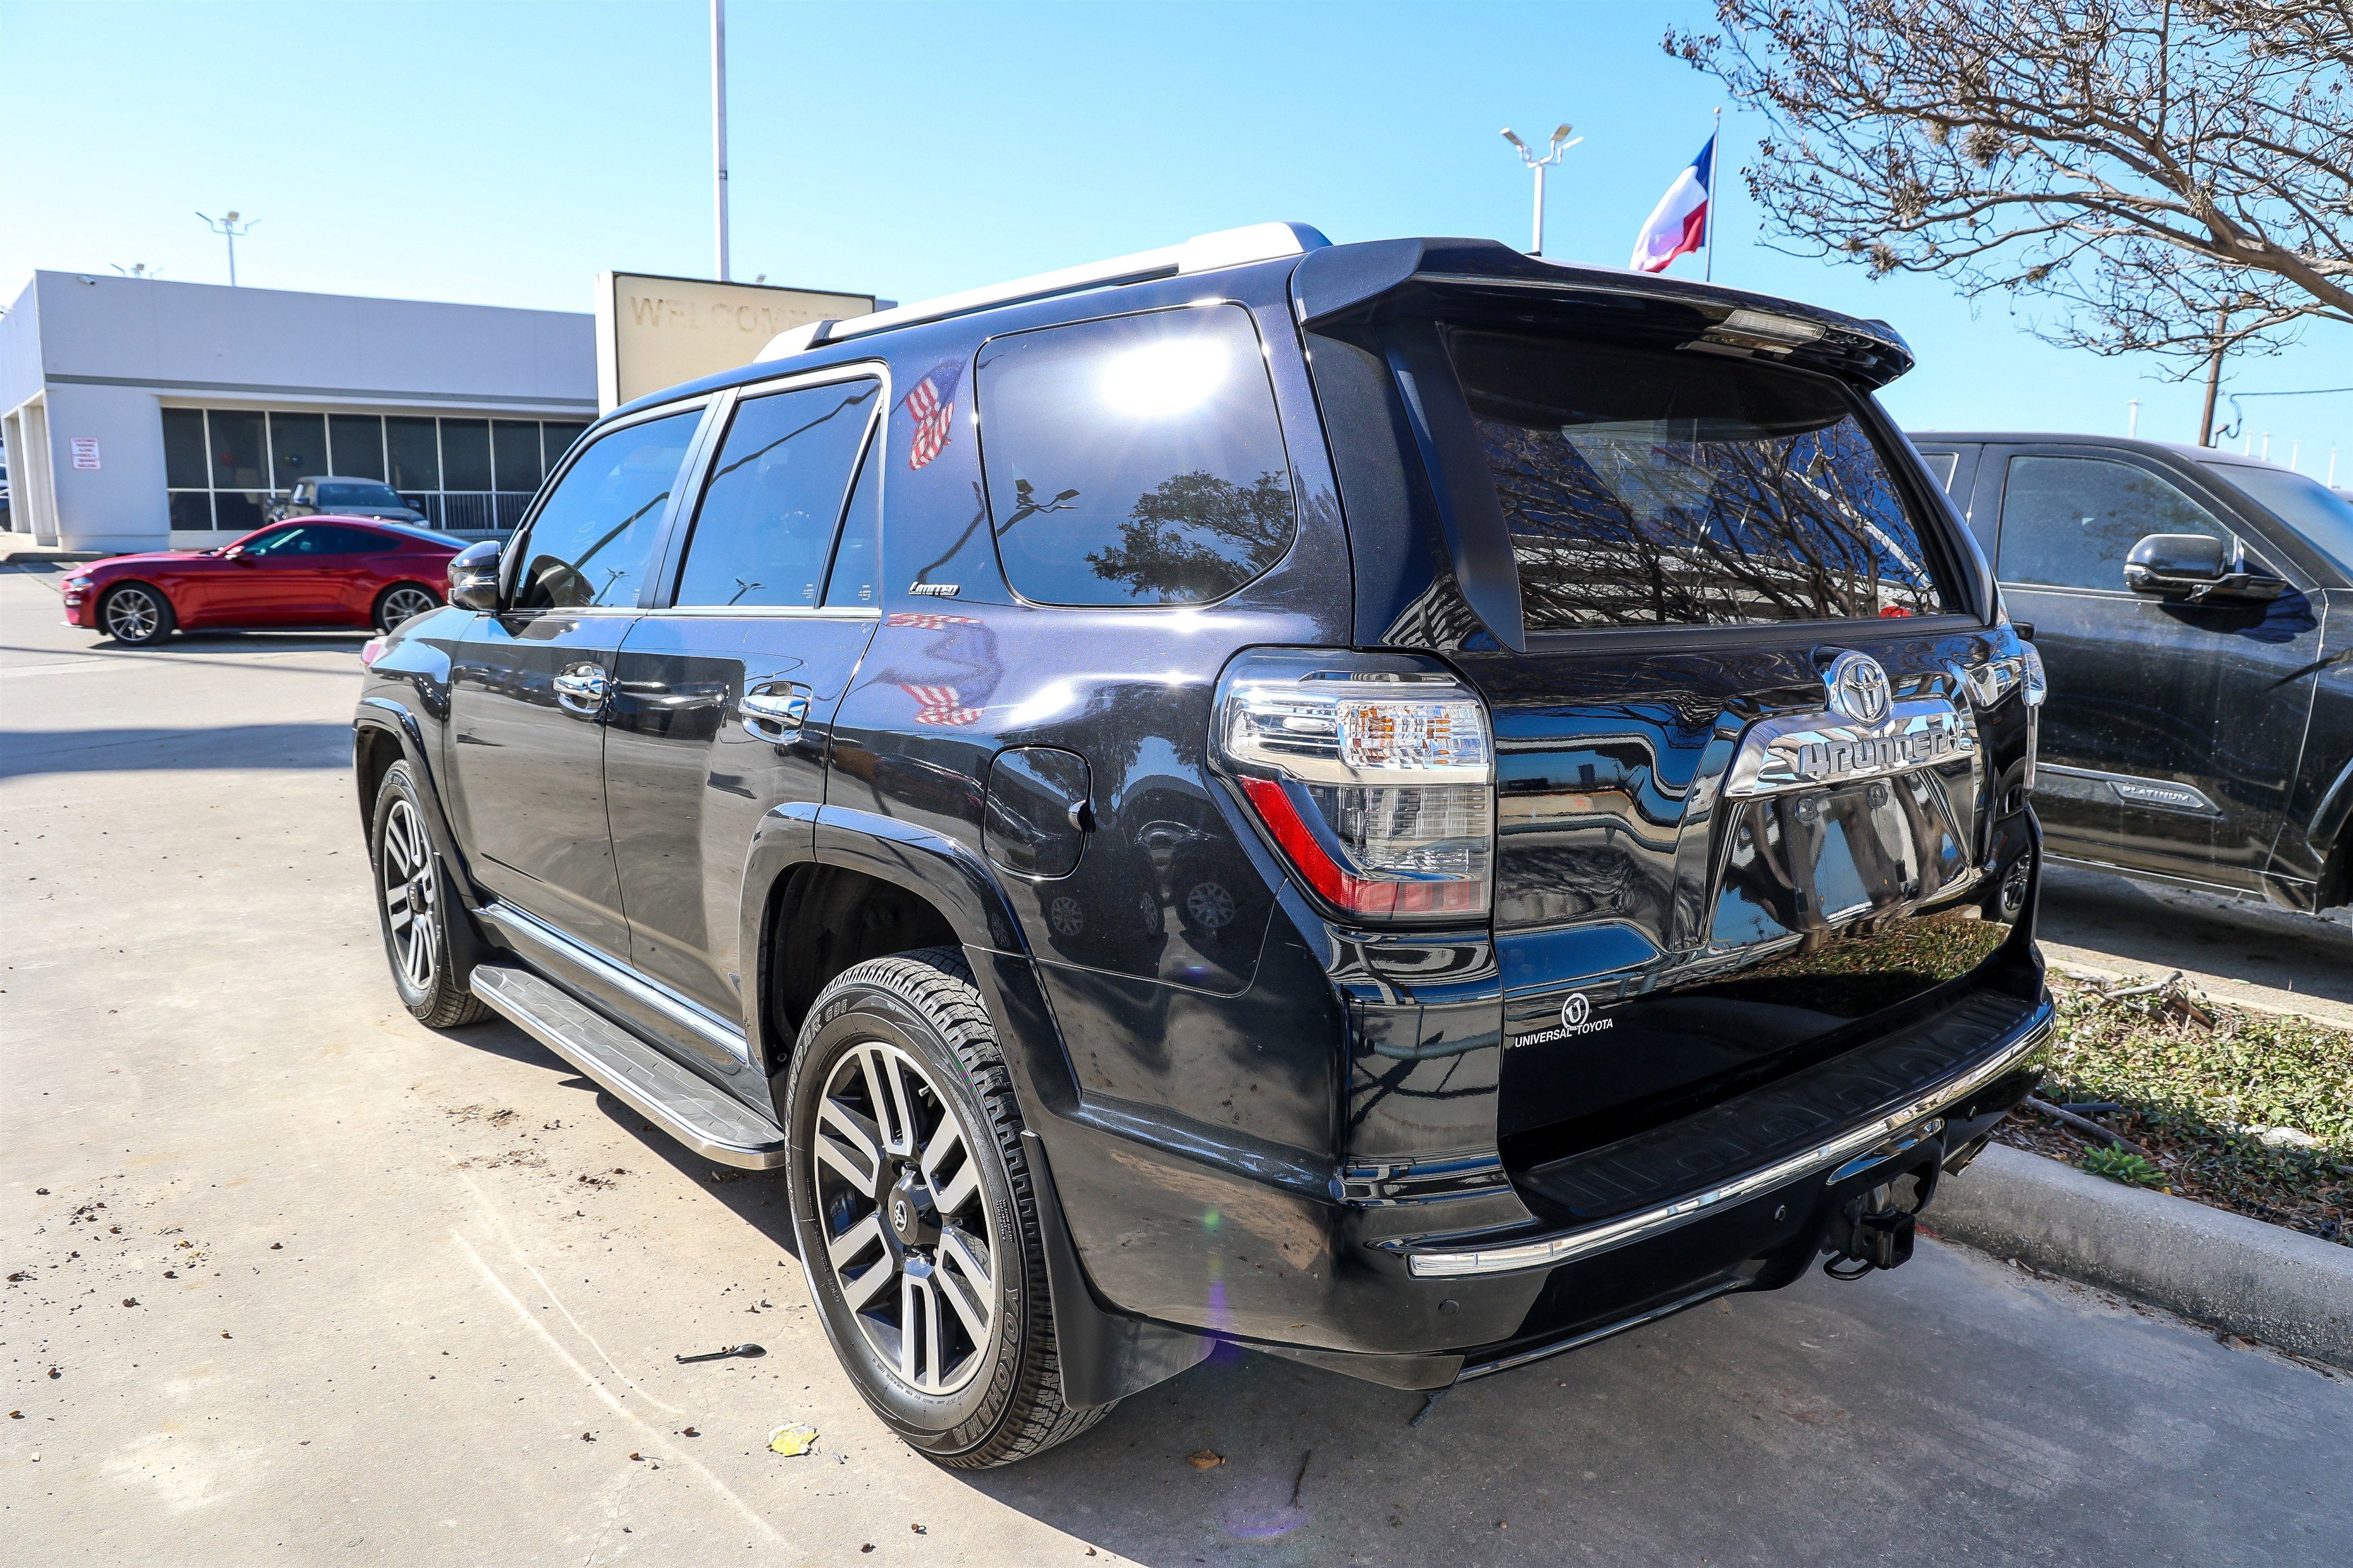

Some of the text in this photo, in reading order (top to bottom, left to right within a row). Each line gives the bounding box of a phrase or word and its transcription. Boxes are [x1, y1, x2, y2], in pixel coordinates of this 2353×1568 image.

[824, 999, 848, 1022] G96
[1515, 1018, 1613, 1048] UNIVERSAL TOYOTA
[952, 1288, 1019, 1446] YOKOHAMA
